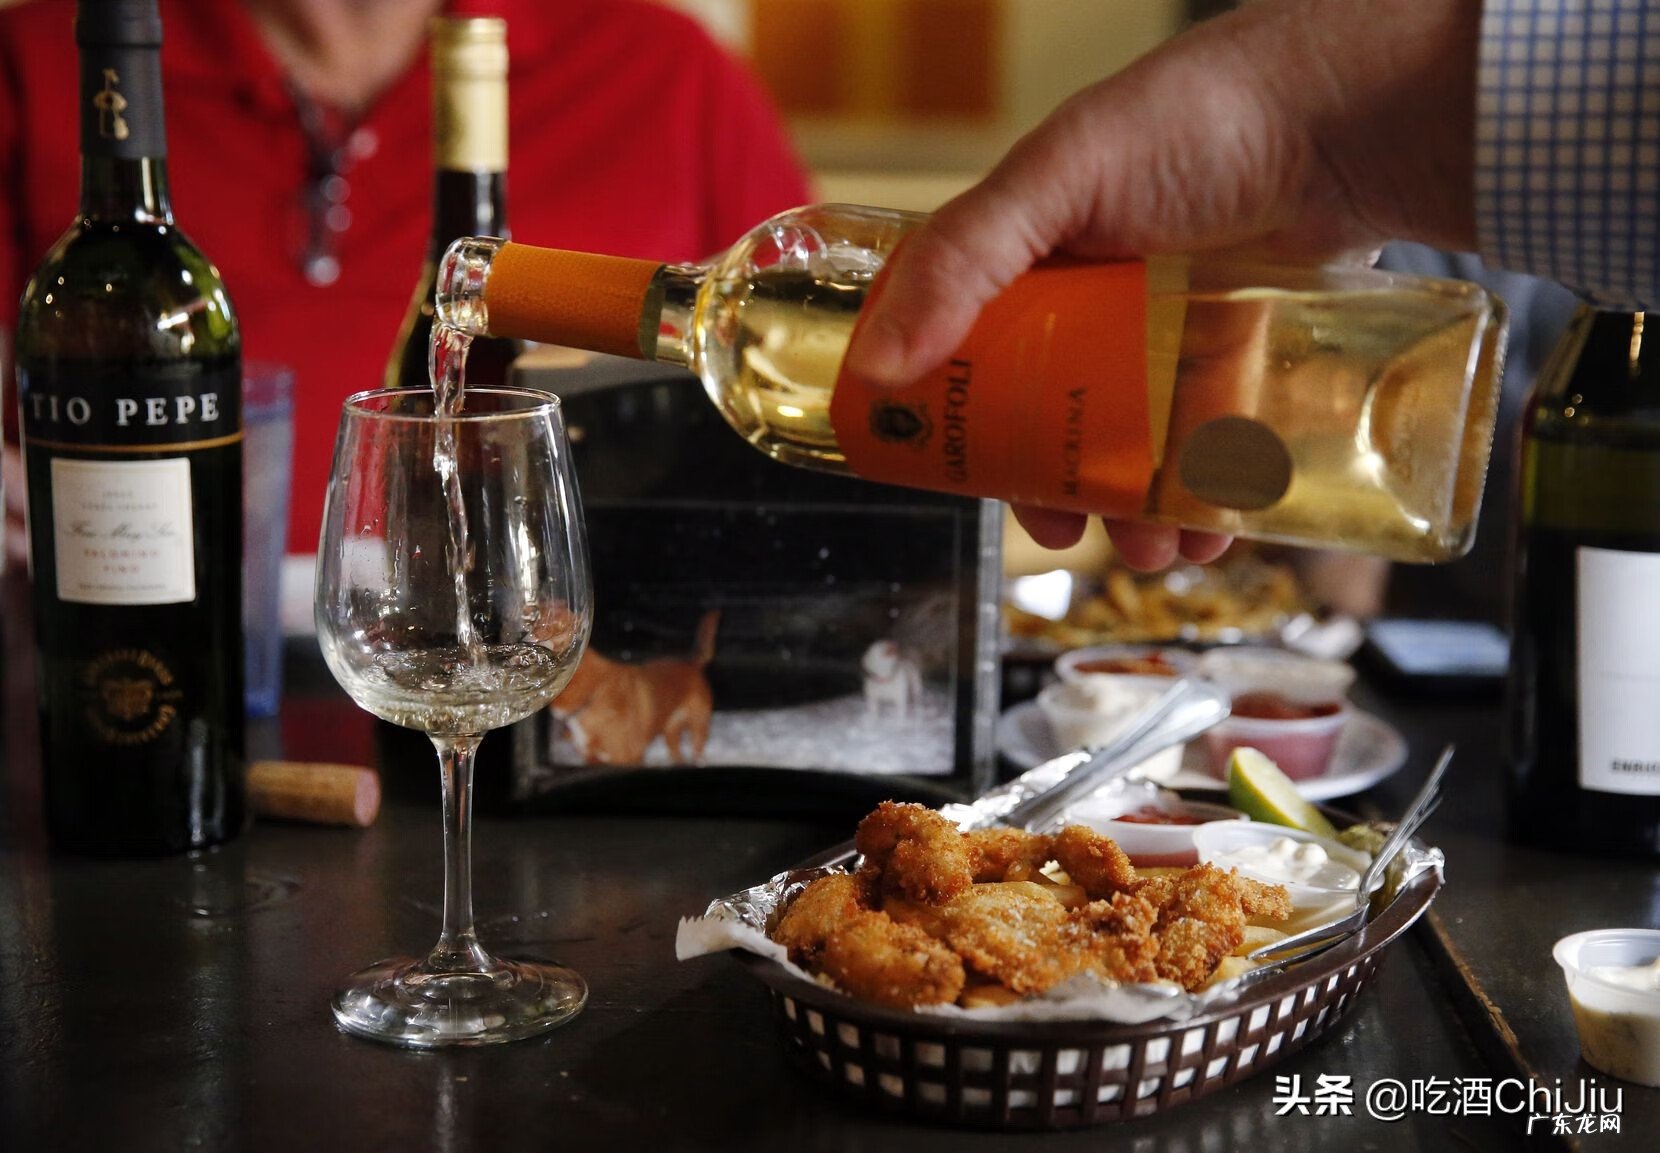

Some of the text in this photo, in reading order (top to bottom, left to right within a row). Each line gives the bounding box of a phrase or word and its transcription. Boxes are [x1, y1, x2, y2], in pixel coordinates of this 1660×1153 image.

[31, 393, 219, 426] TIO PEPE
[945, 359, 972, 483] GAROFOLI
